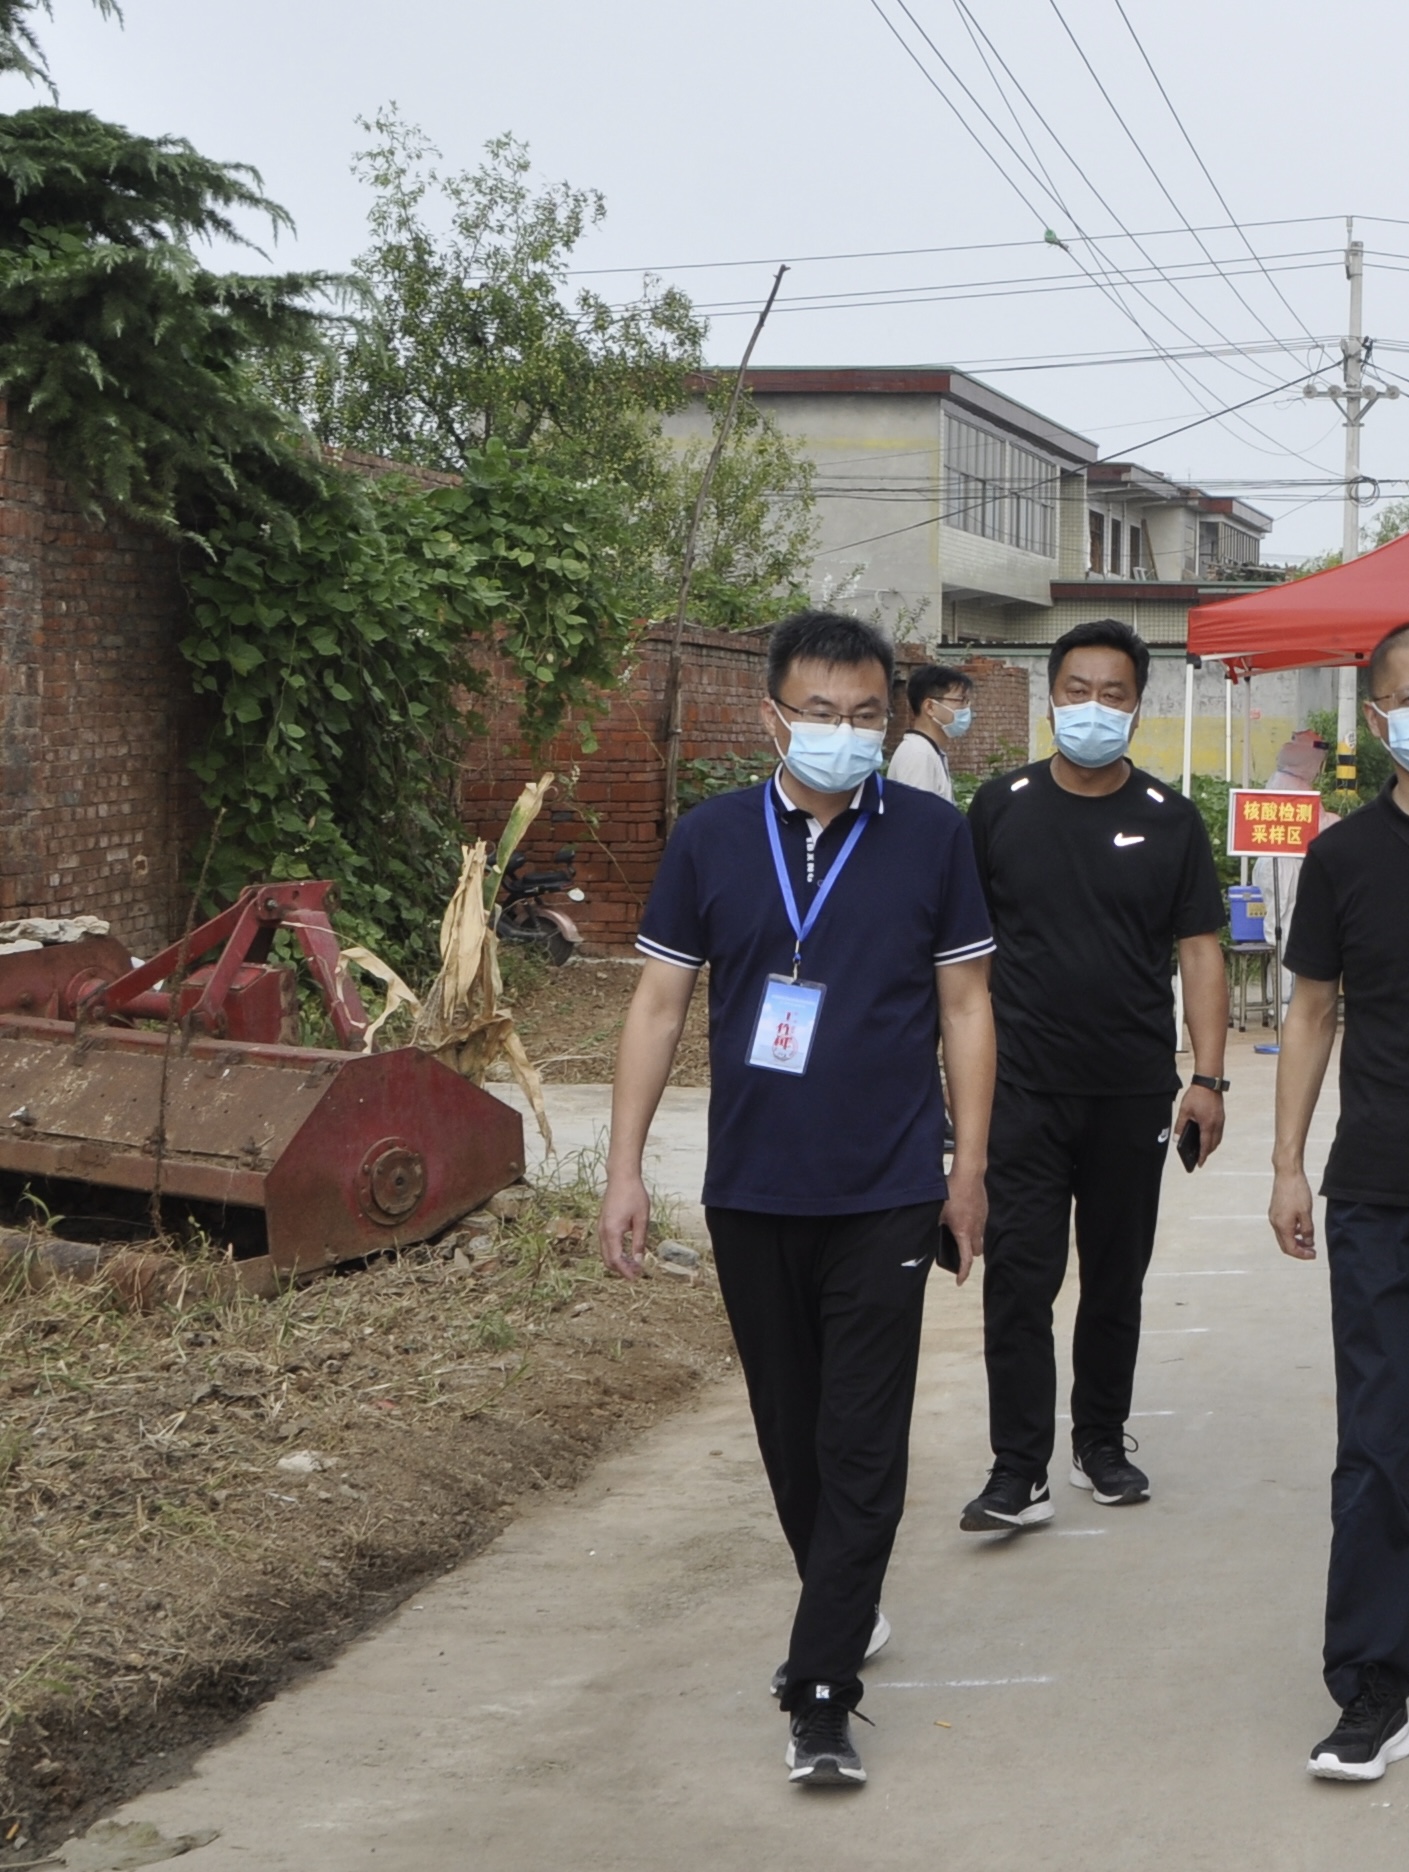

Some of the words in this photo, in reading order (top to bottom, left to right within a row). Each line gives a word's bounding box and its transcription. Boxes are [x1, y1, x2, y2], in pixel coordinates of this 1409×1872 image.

[1243, 800, 1313, 824] 核酸检测
[1251, 824, 1302, 845] 采样区
